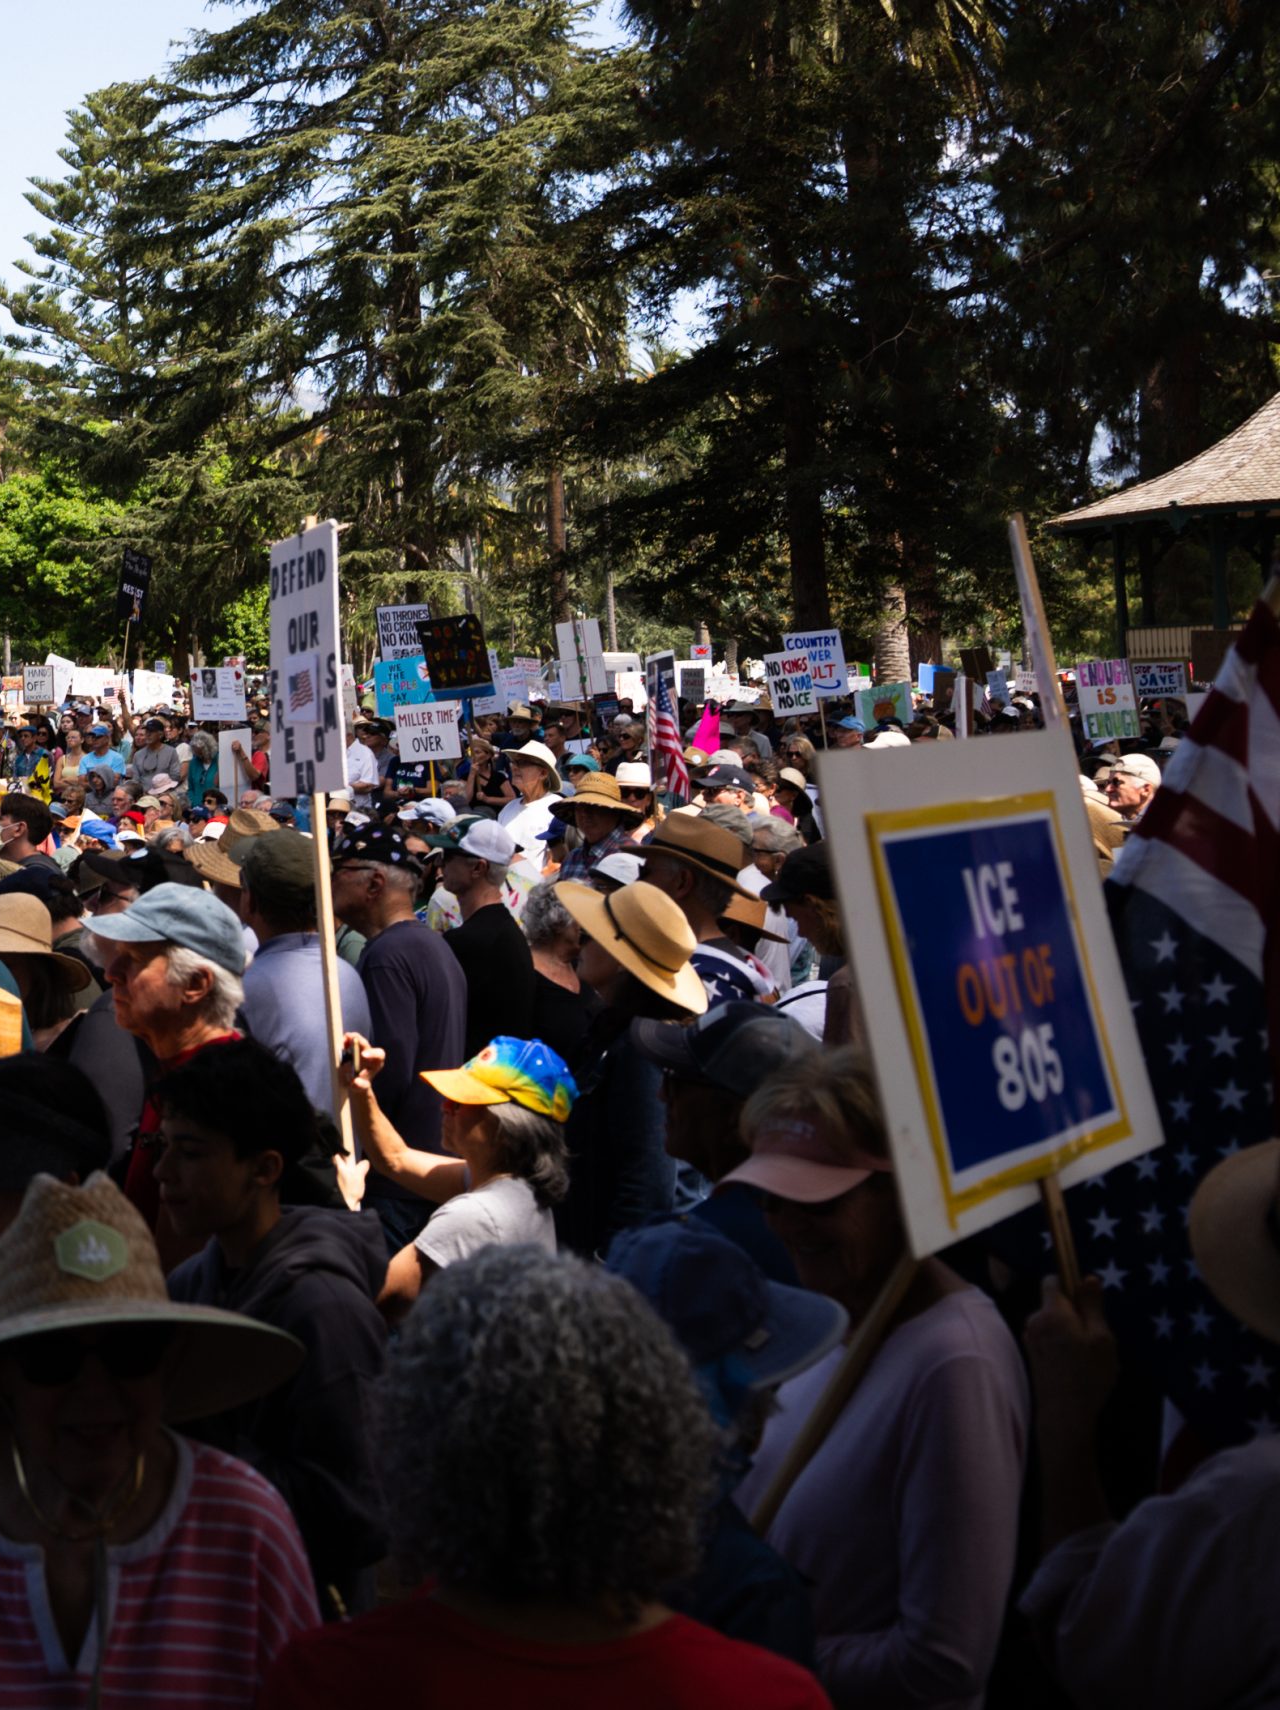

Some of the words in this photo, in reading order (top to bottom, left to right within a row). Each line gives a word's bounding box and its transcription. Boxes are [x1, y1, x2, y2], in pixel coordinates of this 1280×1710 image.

[271, 547, 326, 601] DEFEND
[122, 583, 144, 599] RESIST
[379, 612, 391, 622] NO
[392, 609, 430, 622] THRONES
[287, 610, 320, 654] OUR
[380, 622, 393, 633] NO
[382, 632, 397, 647] NO
[786, 635, 837, 651] COUNTRY
[808, 650, 832, 662] VER
[28, 668, 52, 678] HANDS
[388, 664, 401, 672] WE
[766, 661, 781, 677] NO
[781, 656, 808, 675] KINGS
[812, 664, 836, 680] ULT
[1079, 659, 1132, 687] ENOUGH
[1134, 665, 1151, 675] STOP
[1156, 664, 1182, 673] TRUMP
[388, 671, 405, 681] THE
[773, 679, 790, 694] NO
[791, 674, 813, 691] WAR
[1140, 674, 1175, 687] SAVE
[26, 681, 45, 691] OFF
[380, 679, 418, 694] PEOPLE
[391, 692, 407, 702] SAY
[778, 695, 794, 709] NO
[794, 692, 812, 707] ICE
[398, 711, 434, 728] MILLER
[436, 709, 454, 724] TIME
[1086, 709, 1141, 739] ENOUGH
[421, 727, 429, 735] IS
[412, 735, 443, 752] OVER
[962, 861, 1024, 939] ICE
[955, 953, 1021, 1028] OUT
[1022, 944, 1056, 1007] OF
[992, 1023, 1064, 1112] 805
